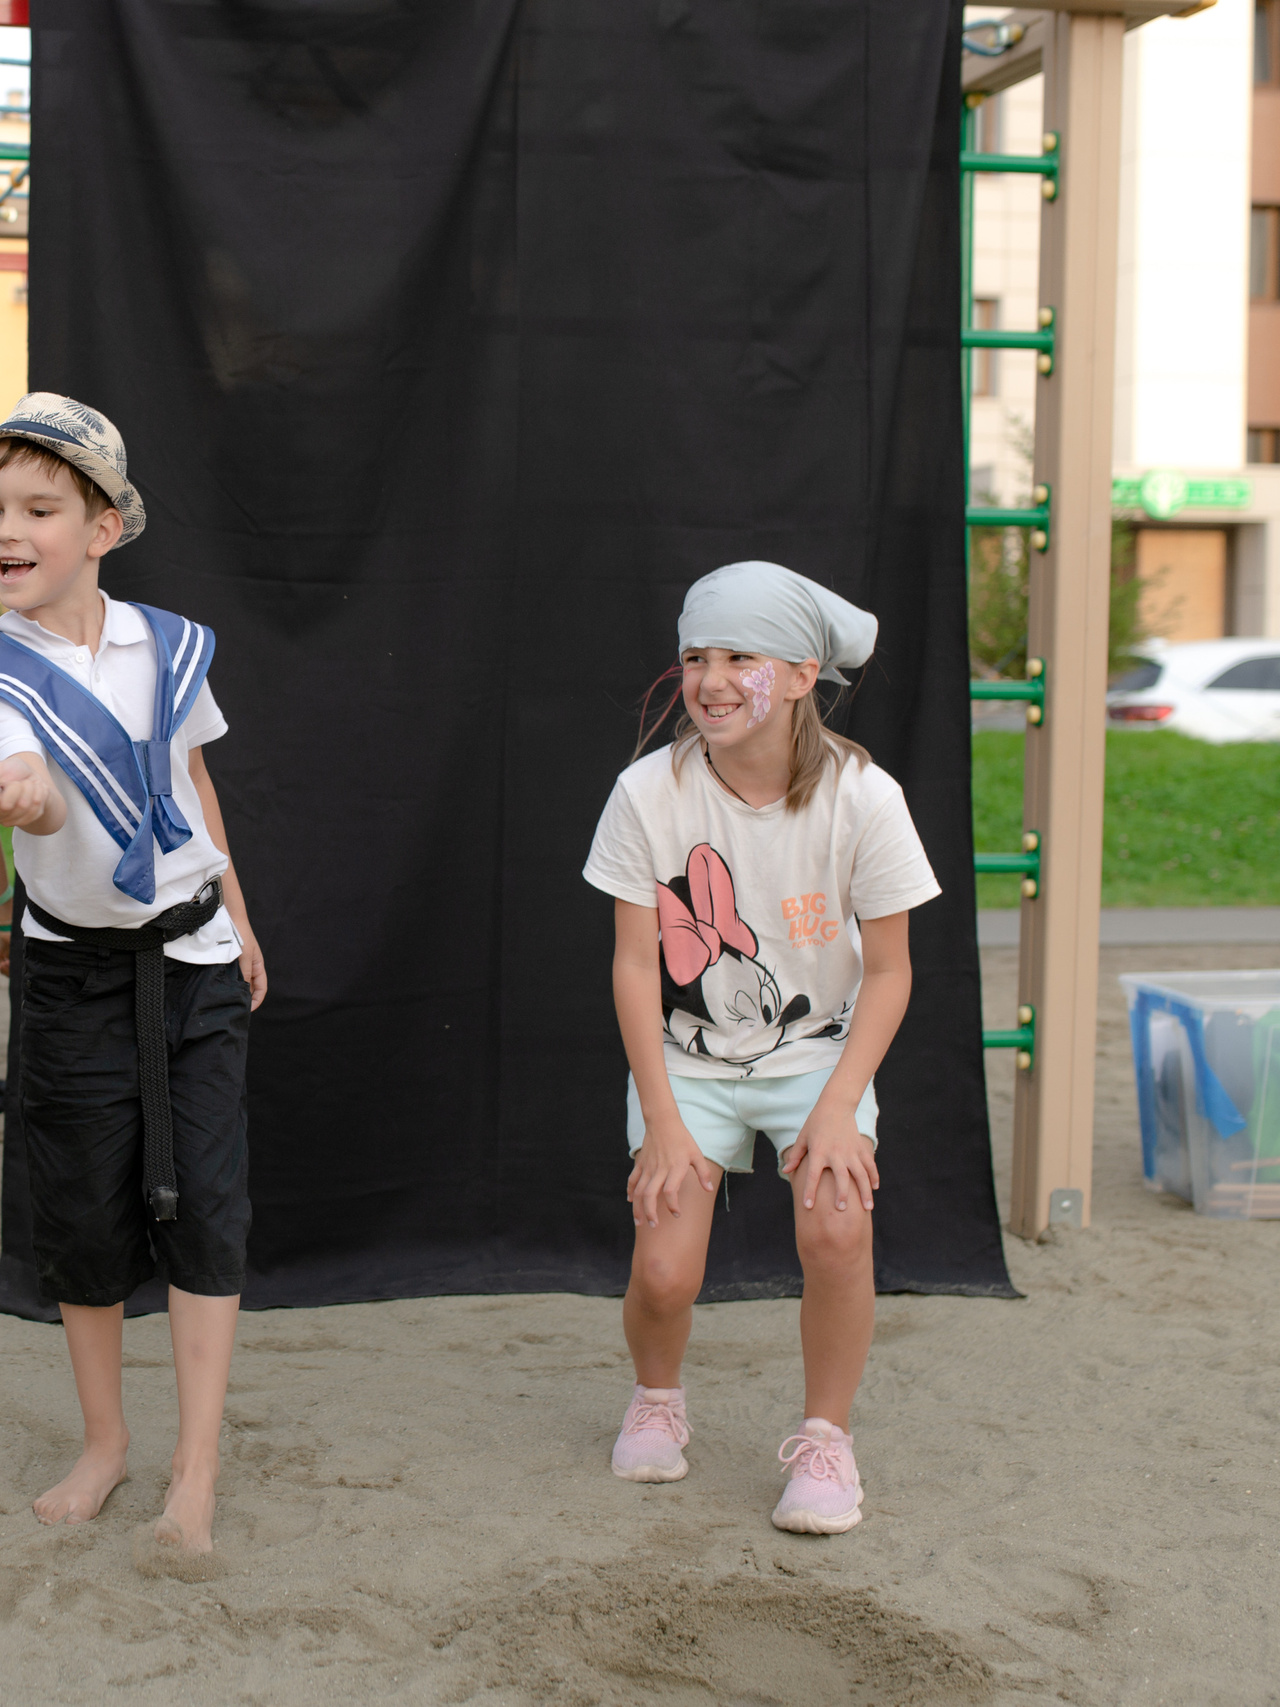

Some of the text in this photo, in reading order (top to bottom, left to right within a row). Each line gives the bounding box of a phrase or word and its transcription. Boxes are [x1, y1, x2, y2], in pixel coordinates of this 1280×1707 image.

[781, 892, 826, 920] BIG
[788, 914, 839, 942] HUG
[807, 938, 826, 948] YOU
